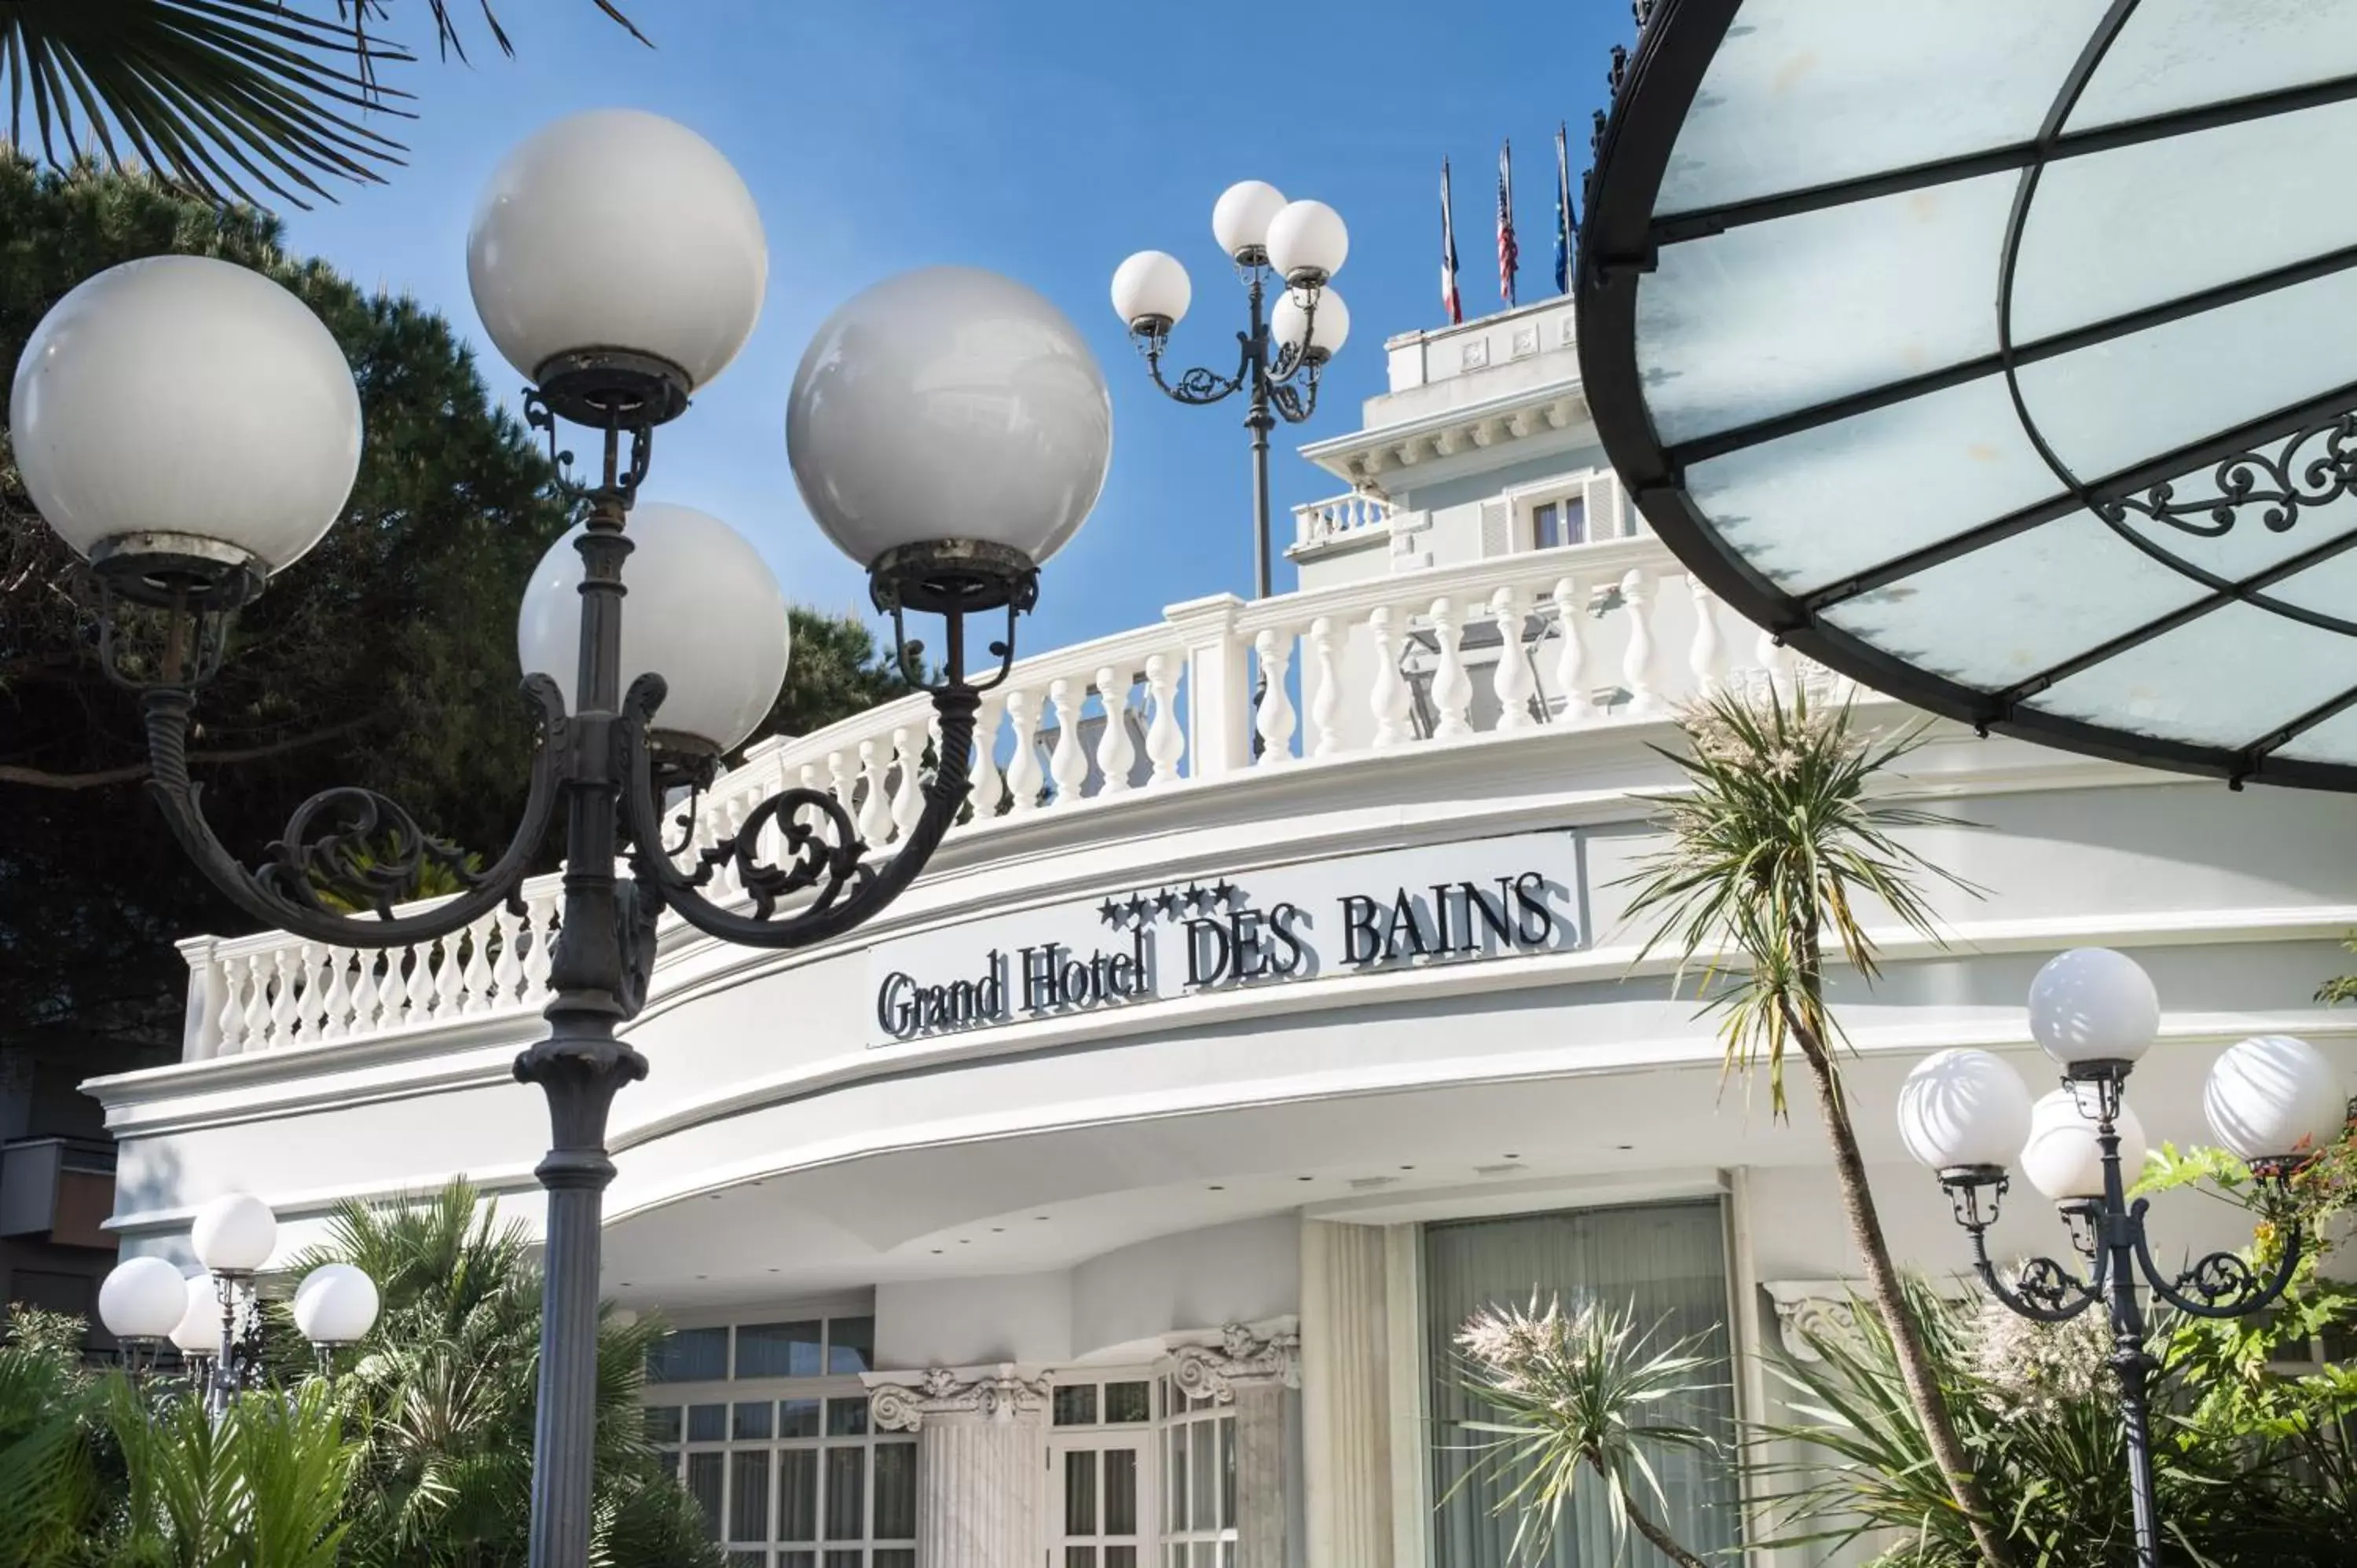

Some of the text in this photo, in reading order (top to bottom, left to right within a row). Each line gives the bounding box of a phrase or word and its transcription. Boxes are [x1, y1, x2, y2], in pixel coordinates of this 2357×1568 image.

[877, 871, 1552, 1036] Grand Hotel DES BAINS
